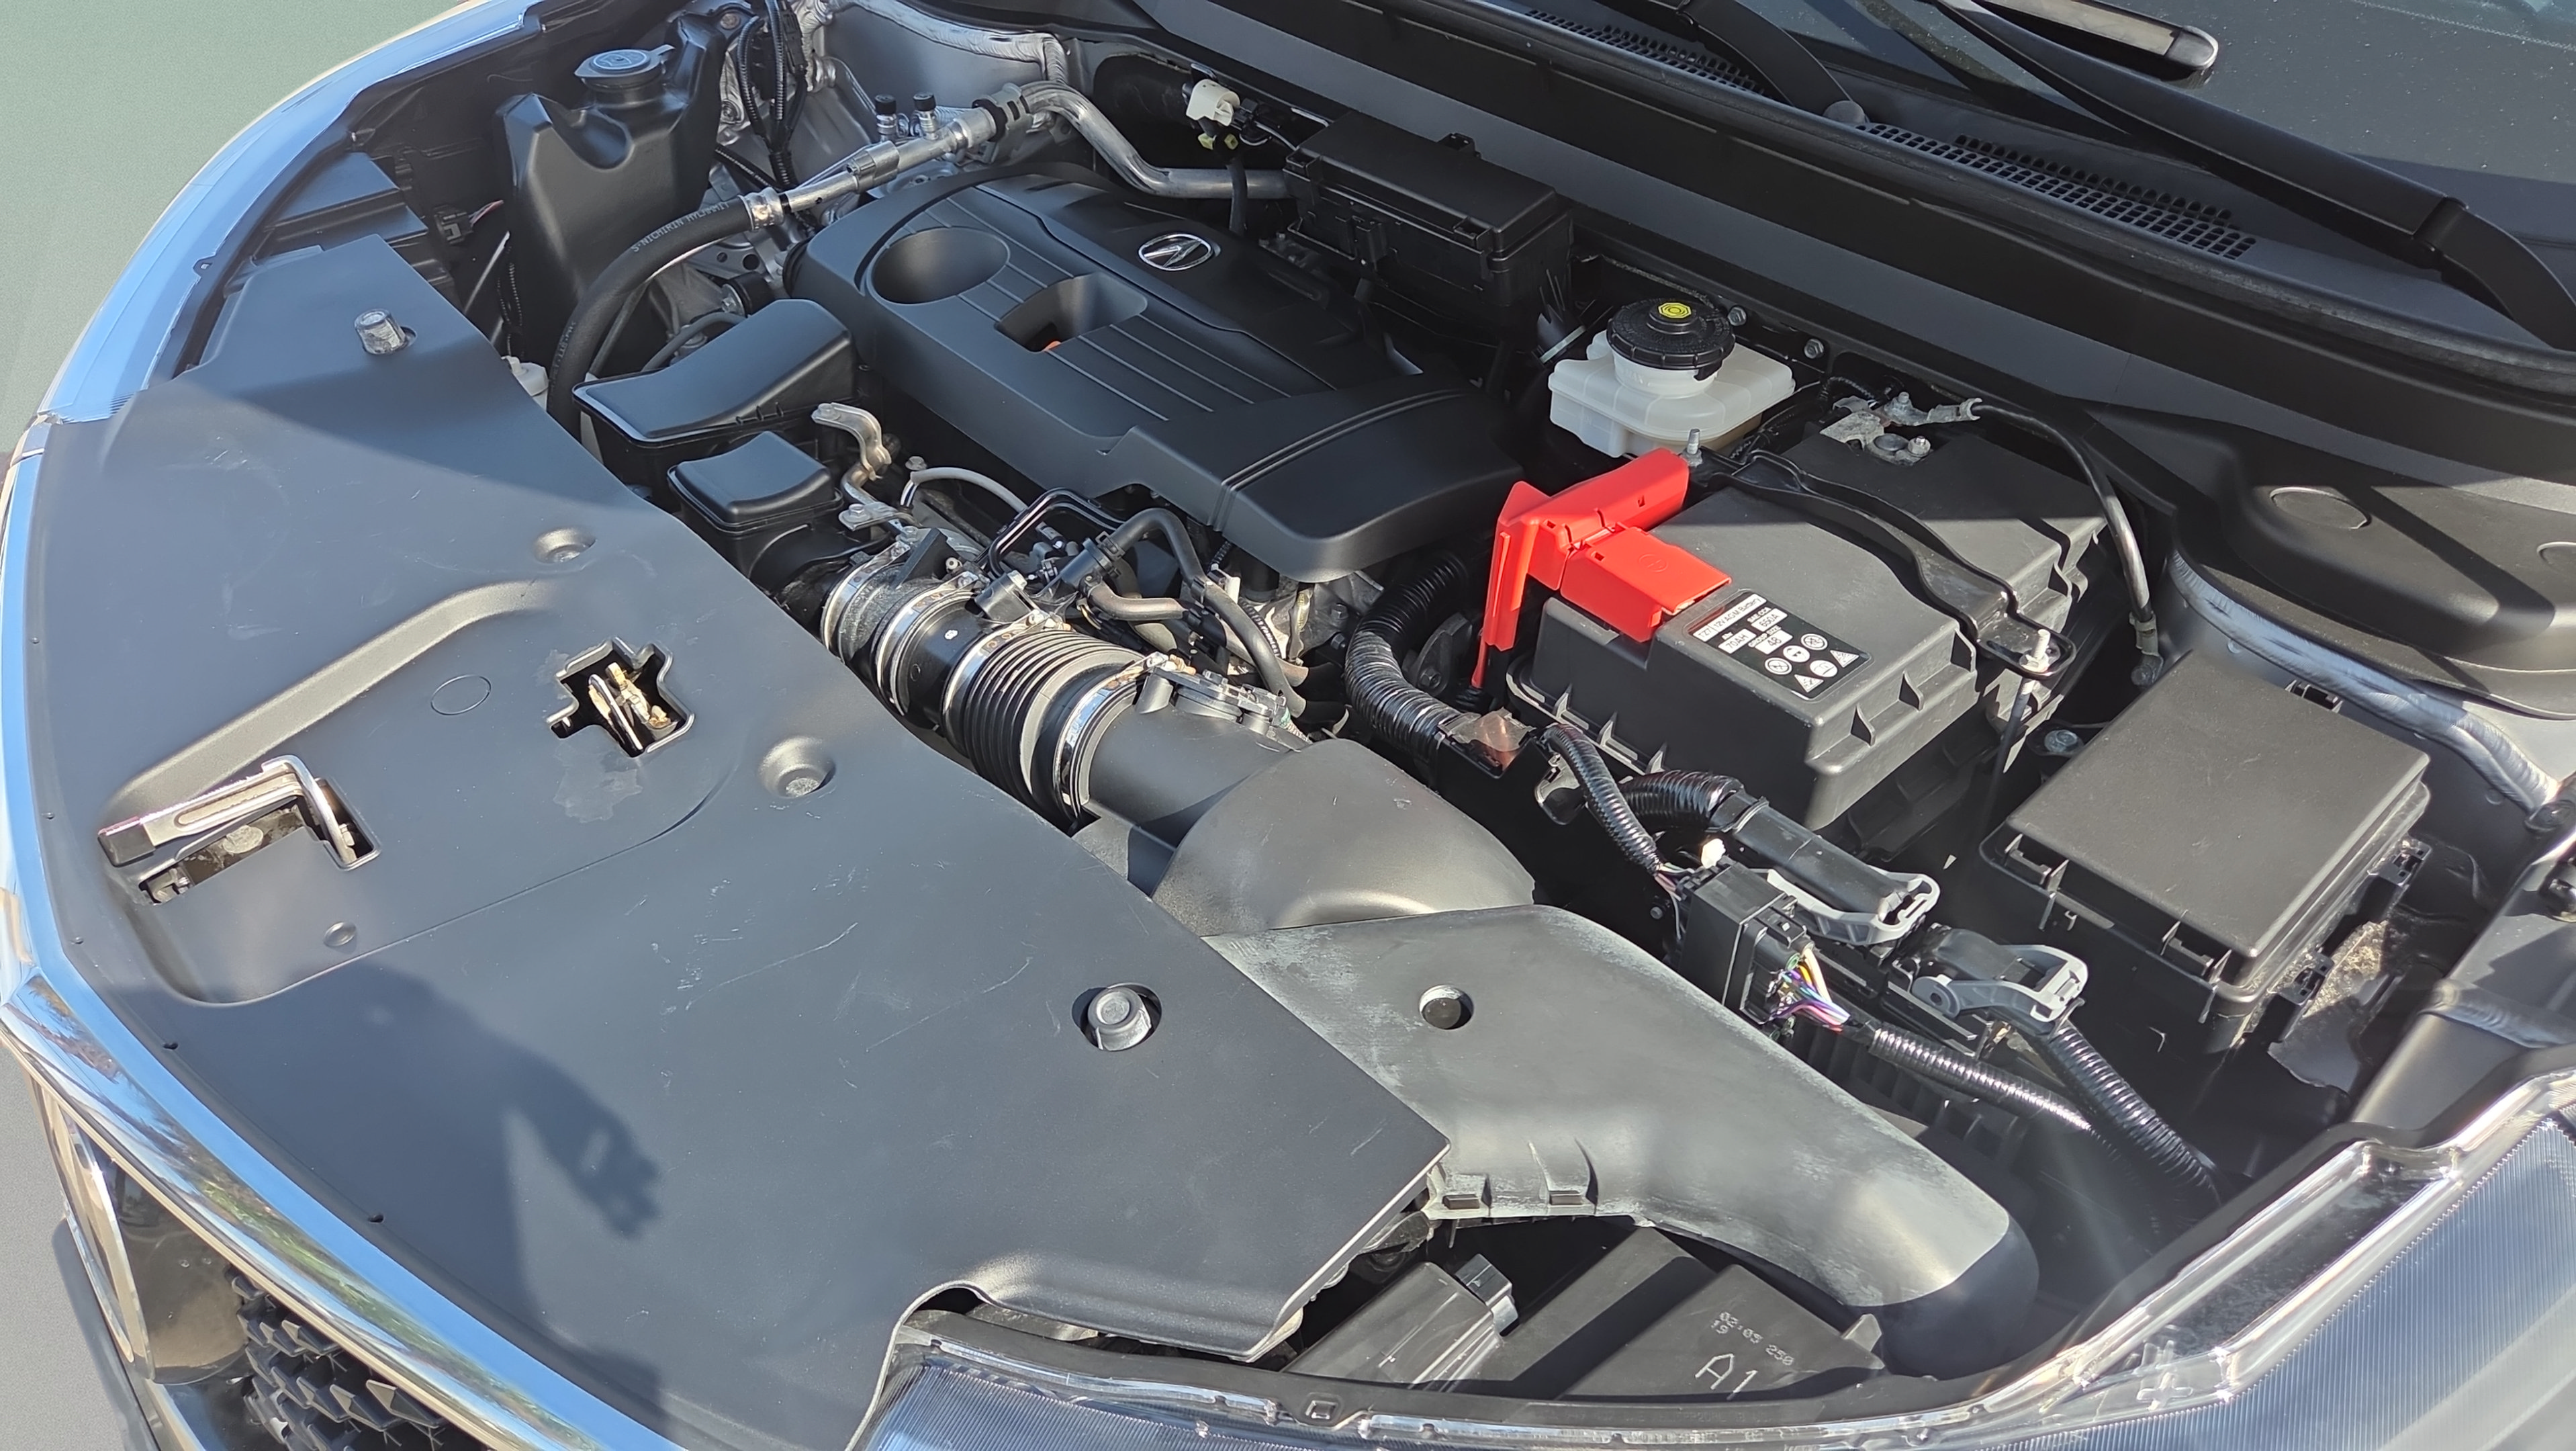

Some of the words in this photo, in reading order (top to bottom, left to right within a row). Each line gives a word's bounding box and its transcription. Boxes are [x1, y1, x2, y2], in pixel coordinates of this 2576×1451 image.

[1767, 637, 1782, 646] 48
[1765, 1344, 1794, 1366] 250
[1695, 1354, 1758, 1401] A1
